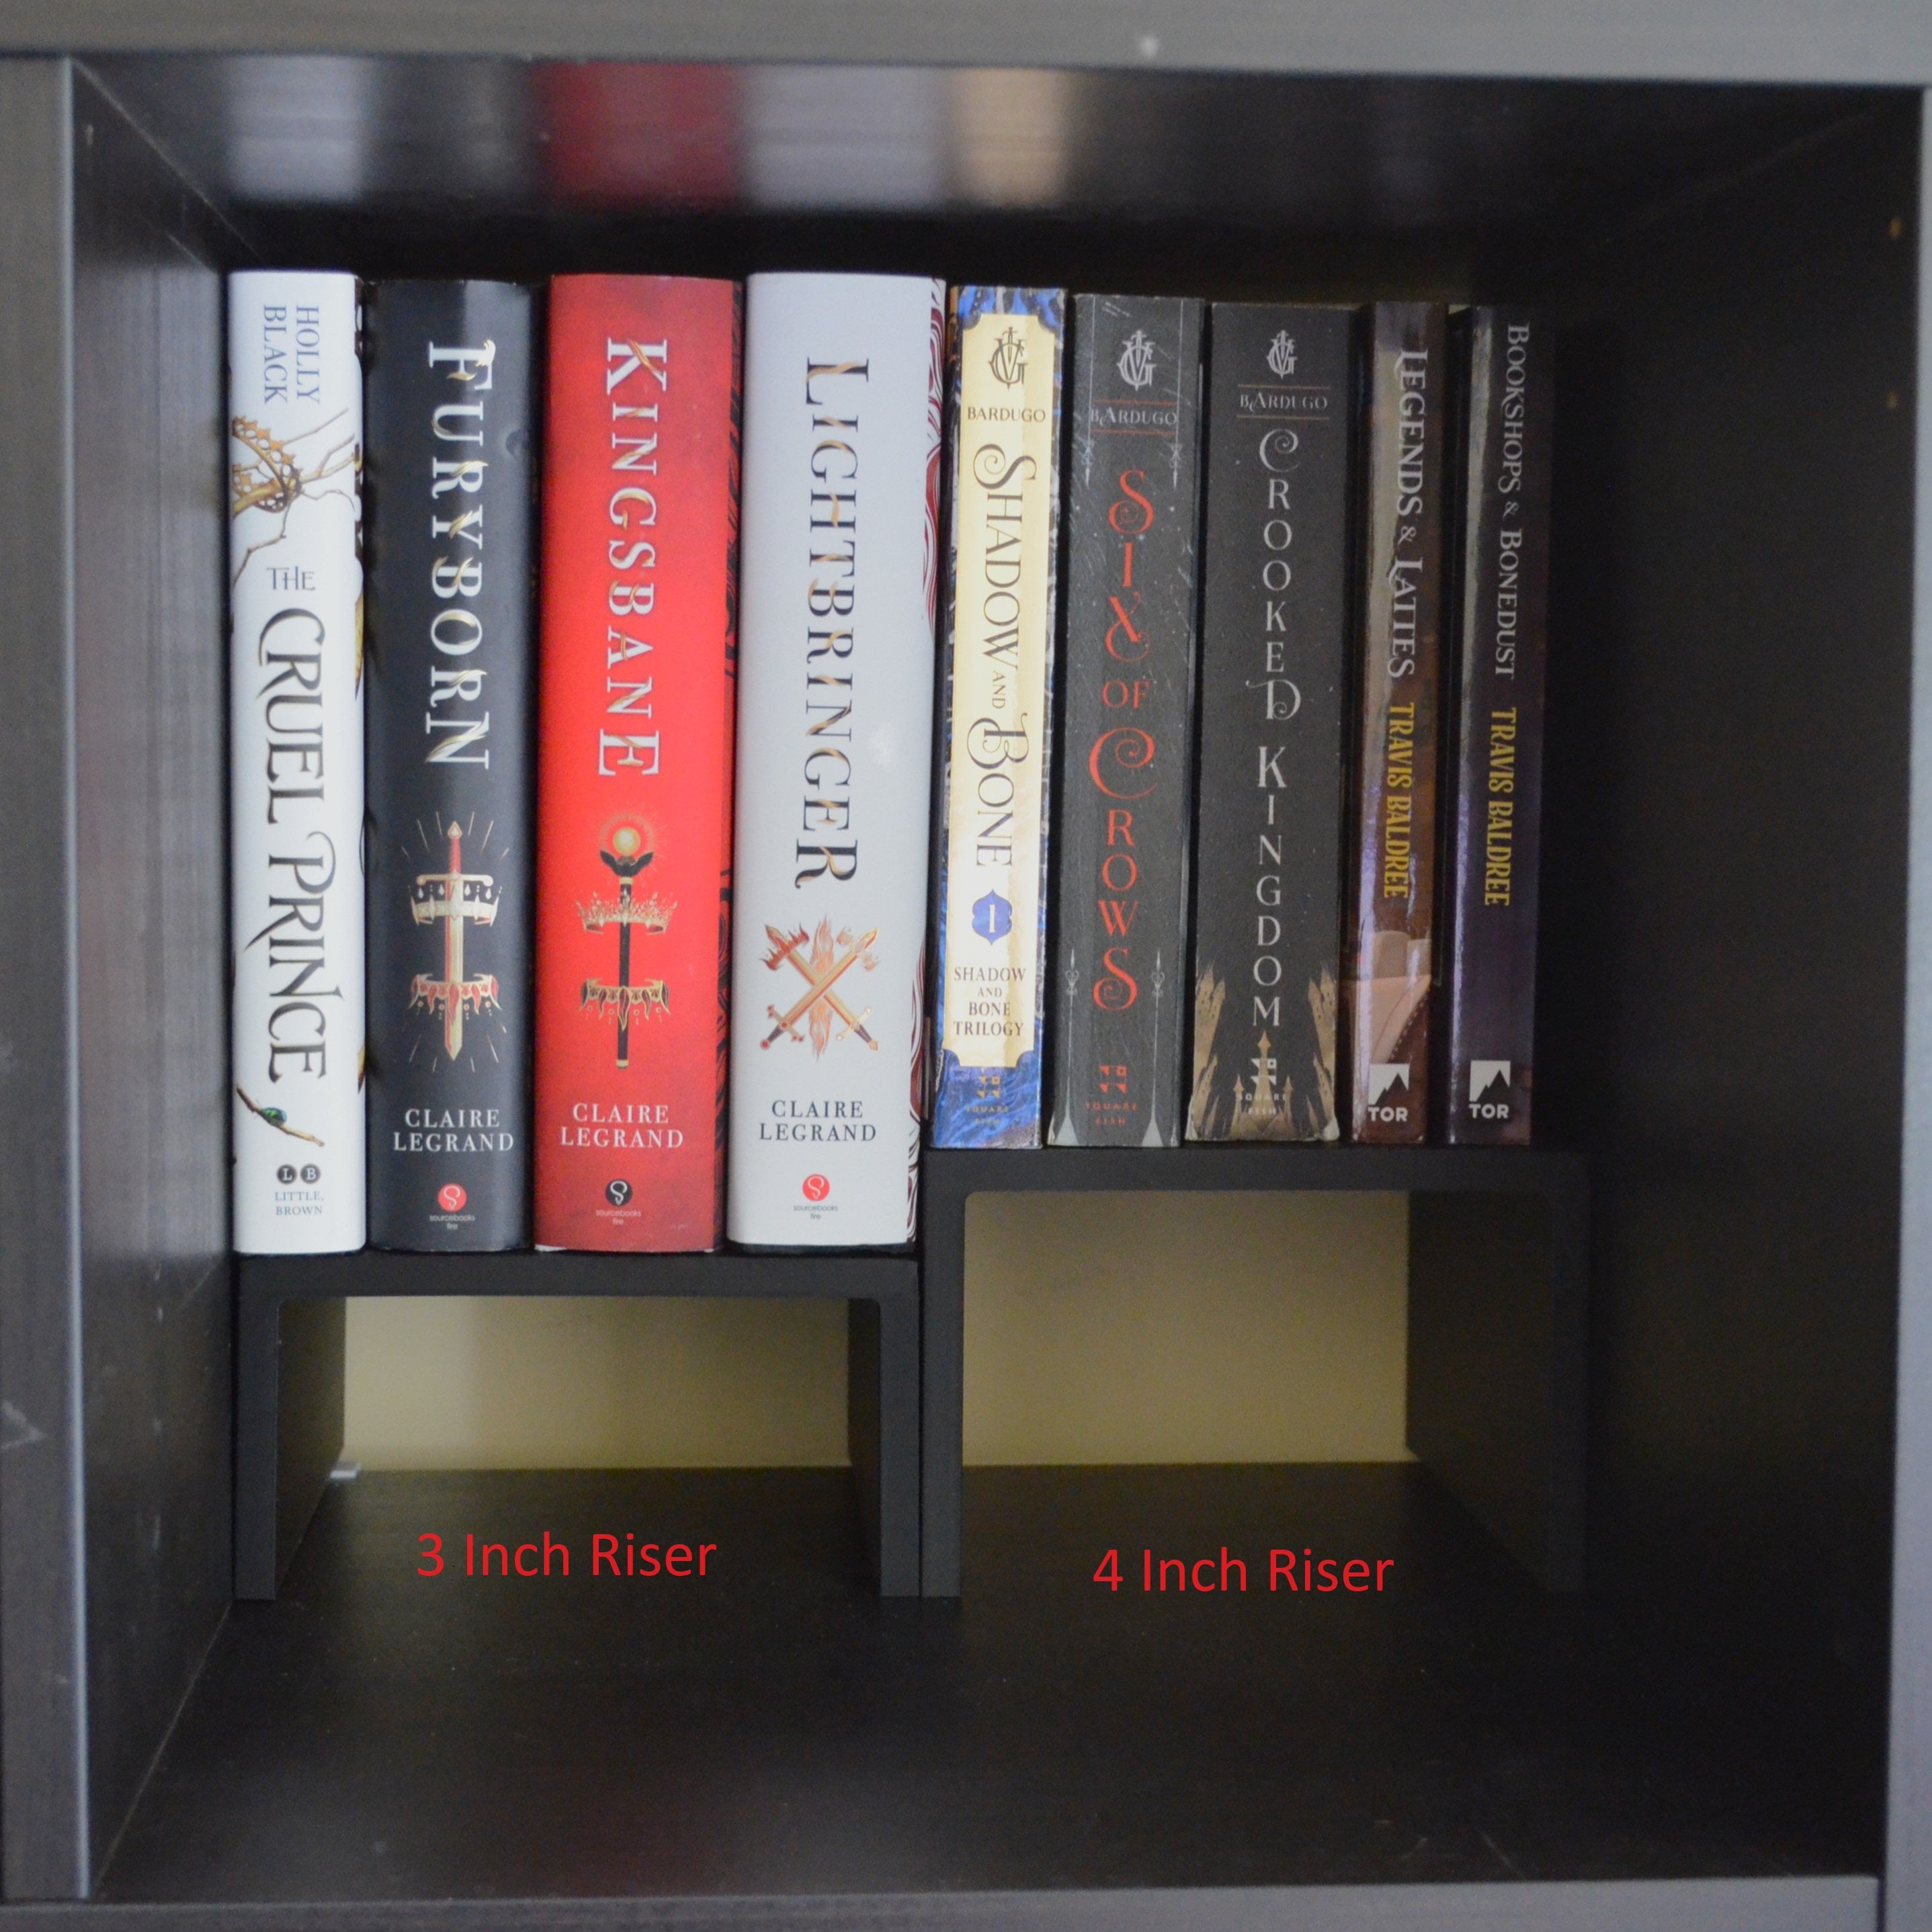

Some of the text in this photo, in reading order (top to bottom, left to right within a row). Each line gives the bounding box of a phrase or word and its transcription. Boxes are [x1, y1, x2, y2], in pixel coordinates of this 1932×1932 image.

[263, 304, 288, 403] BLACK
[296, 304, 320, 403] HOLLY
[966, 407, 1046, 423] BARDUGO
[1240, 392, 1328, 414] BARDUGO
[1090, 406, 1178, 427] BARDUGO
[1386, 349, 1429, 679] LEGENDS & LATTES
[1495, 322, 1530, 681] BOOKSHOPS & BONEDUST
[425, 339, 496, 770] FURYBORN
[598, 337, 667, 776] KINGSBANE
[1105, 469, 1154, 663] SIX
[267, 566, 316, 591] THE
[1245, 428, 1302, 720] CROOKED
[795, 358, 870, 889] LIGHTBRINGER
[966, 443, 1038, 868] SHADOW AND BONE
[1102, 679, 1150, 710] OF
[1383, 702, 1415, 900] TRAVIS BALDREE
[1484, 706, 1517, 907] TRAVIS BALDREE
[245, 607, 344, 1084] CRUEL PRINCE
[1089, 726, 1159, 1010] CROWS
[1252, 746, 1288, 1027] KINGDOM
[953, 966, 1027, 983] SHADOW
[977, 986, 1003, 998] AND
[968, 1001, 1011, 1017] BONE
[952, 1021, 1024, 1038] TRILOGY
[404, 1108, 500, 1130] CLAIRE
[572, 1102, 671, 1125] CLAIRE
[771, 1099, 864, 1119] CLAIRE
[1368, 1106, 1409, 1123] TOR
[1469, 1103, 1510, 1120] TOR
[392, 1132, 514, 1152] LEGRAND
[559, 1126, 685, 1150] LEGRAND
[759, 1122, 877, 1142] LEGRAND
[275, 1205, 323, 1216] BROWN
